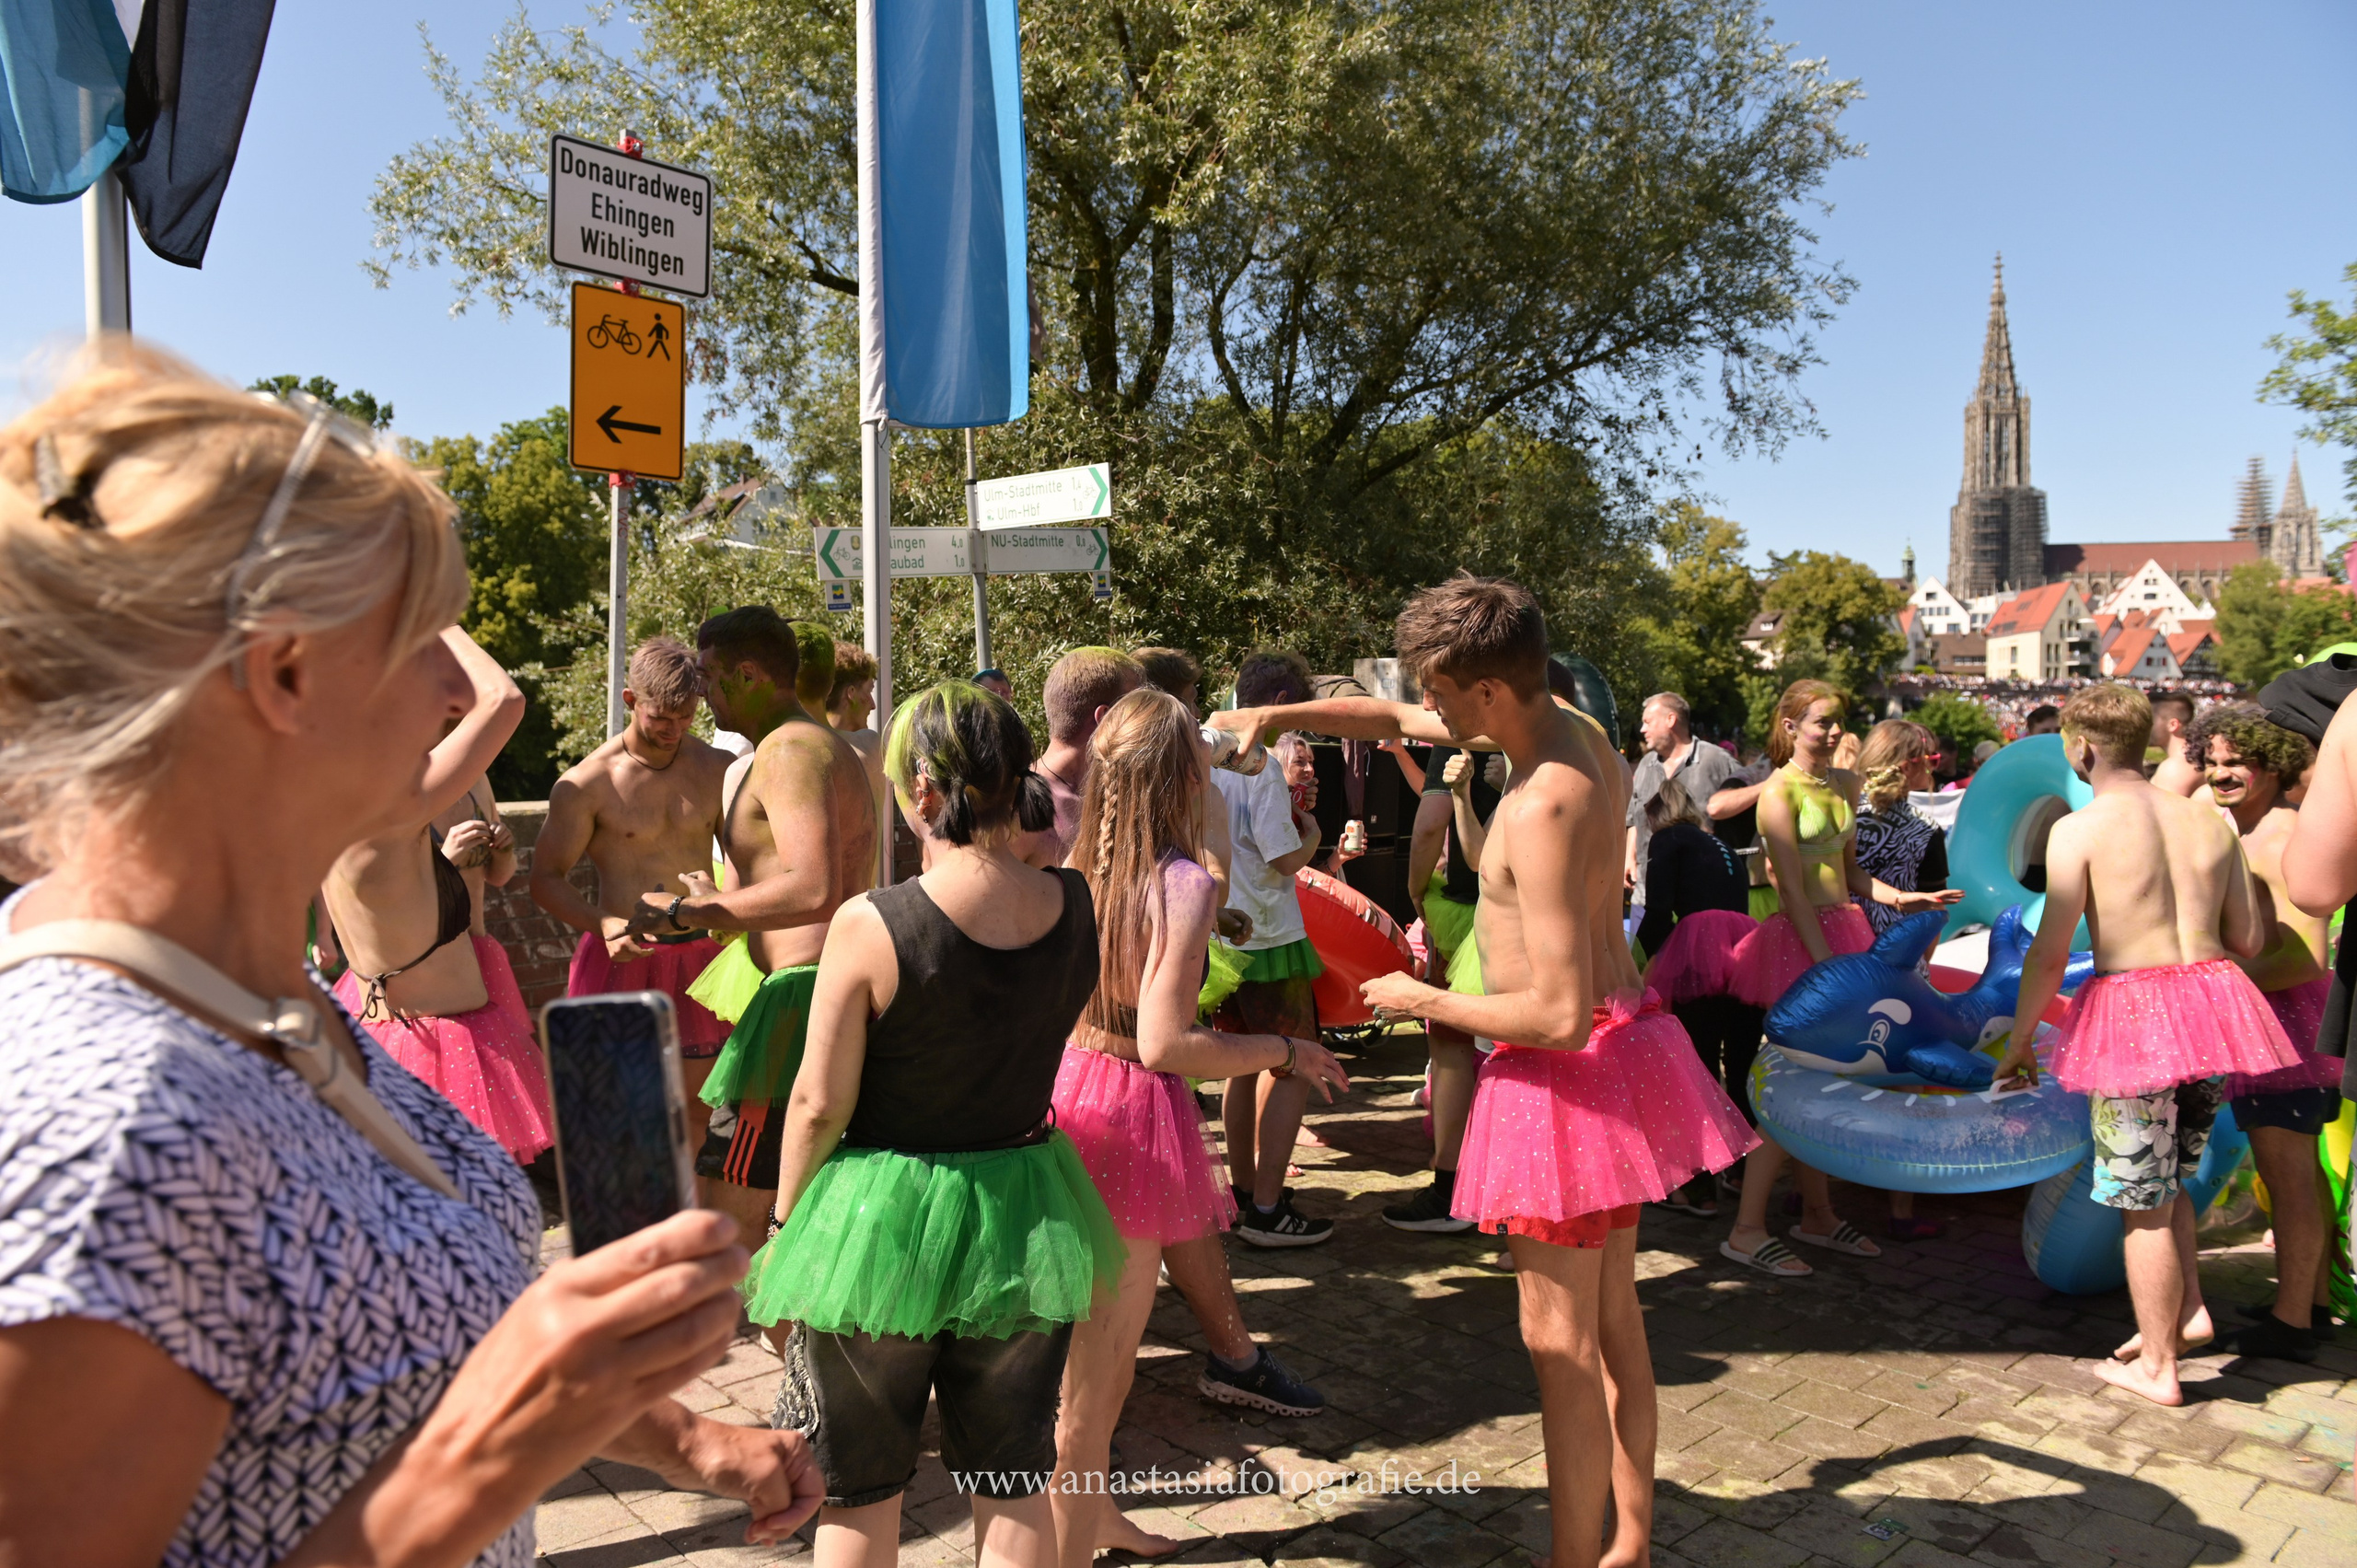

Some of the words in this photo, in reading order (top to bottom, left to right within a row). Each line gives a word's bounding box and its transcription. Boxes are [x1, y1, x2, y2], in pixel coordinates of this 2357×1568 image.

[561, 146, 702, 216] Donauradweg
[591, 192, 674, 238] Ehingen
[580, 226, 684, 276] Wiblingen
[983, 481, 1062, 502] Ulm-Stadtmitte
[997, 503, 1040, 521] Ulm-Hbf
[889, 535, 926, 552] lingen
[991, 534, 1064, 548] NU-Stadtmitte
[890, 554, 925, 570] aubad
[1856, 829, 1879, 844] EGA
